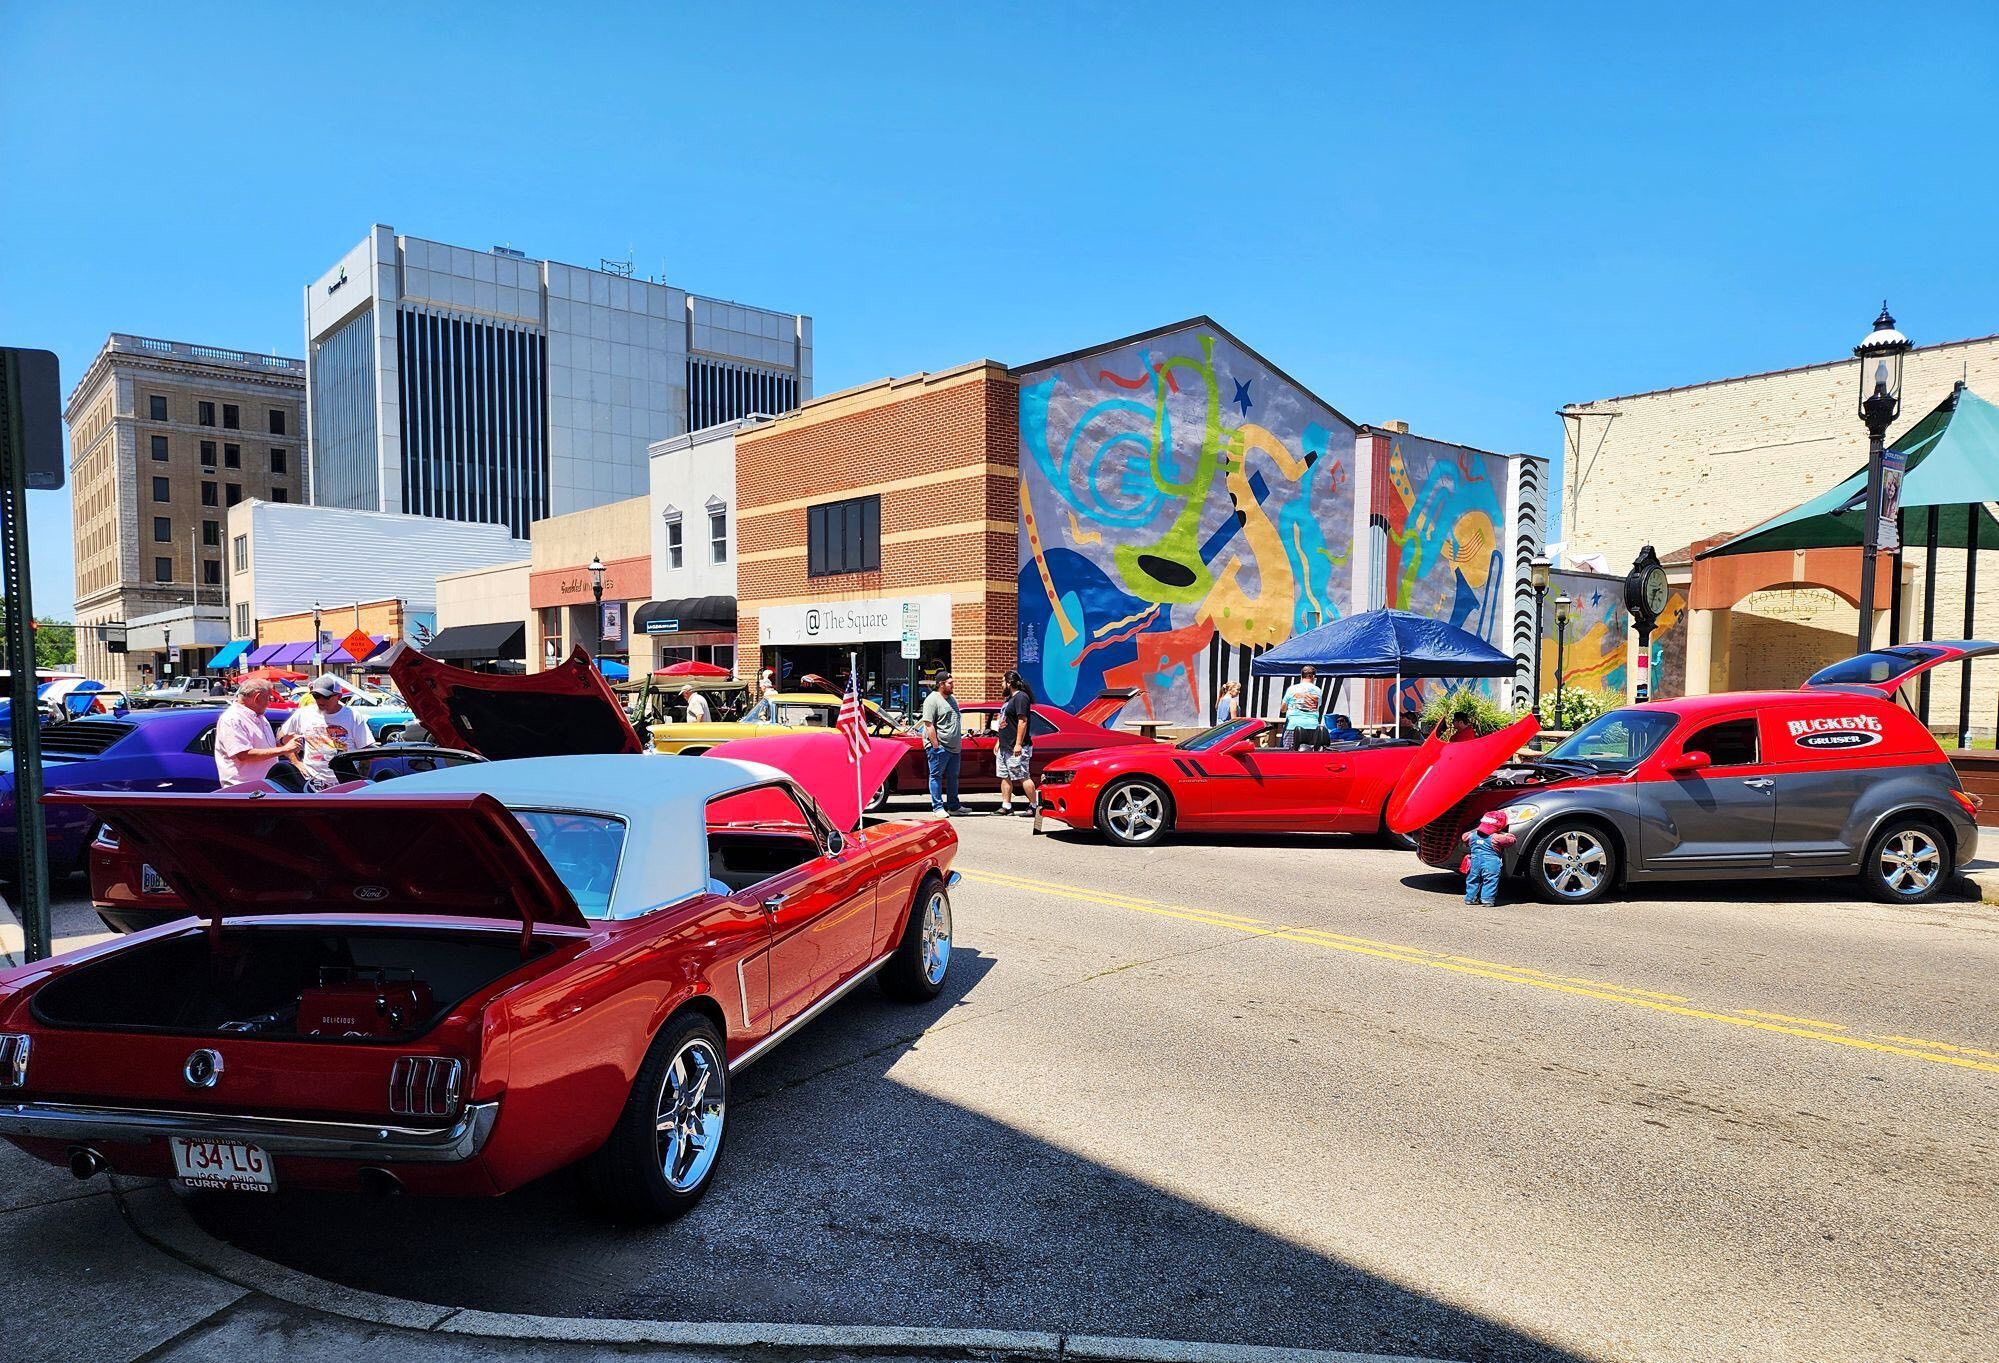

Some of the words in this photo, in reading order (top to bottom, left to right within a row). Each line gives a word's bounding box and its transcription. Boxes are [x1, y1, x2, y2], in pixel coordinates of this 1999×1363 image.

[806, 609, 820, 636] @
[823, 611, 845, 630] The
[847, 610, 888, 634] Square
[1787, 714, 1883, 737] BUCKEYE
[360, 888, 383, 898] Ford
[322, 1016, 355, 1025] DELICIOUS
[185, 1179, 228, 1190] CURRY
[233, 1182, 269, 1193] FORD
